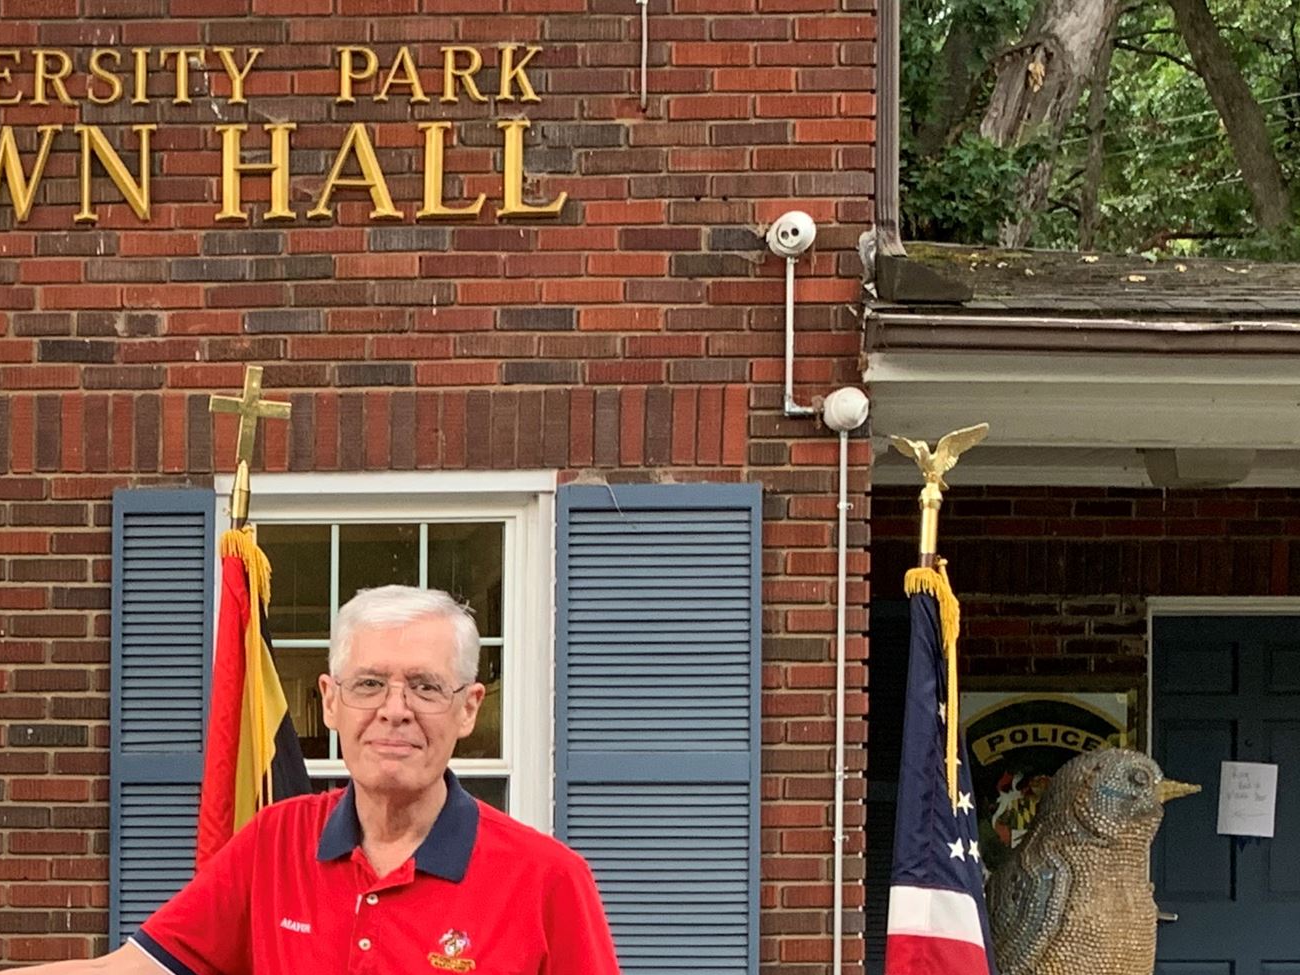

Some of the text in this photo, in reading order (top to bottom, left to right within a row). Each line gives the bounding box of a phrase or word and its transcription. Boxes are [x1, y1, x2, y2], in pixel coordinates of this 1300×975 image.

[335, 42, 543, 103] PARK
[214, 118, 568, 222] HALL
[986, 727, 1102, 752] POLICE
